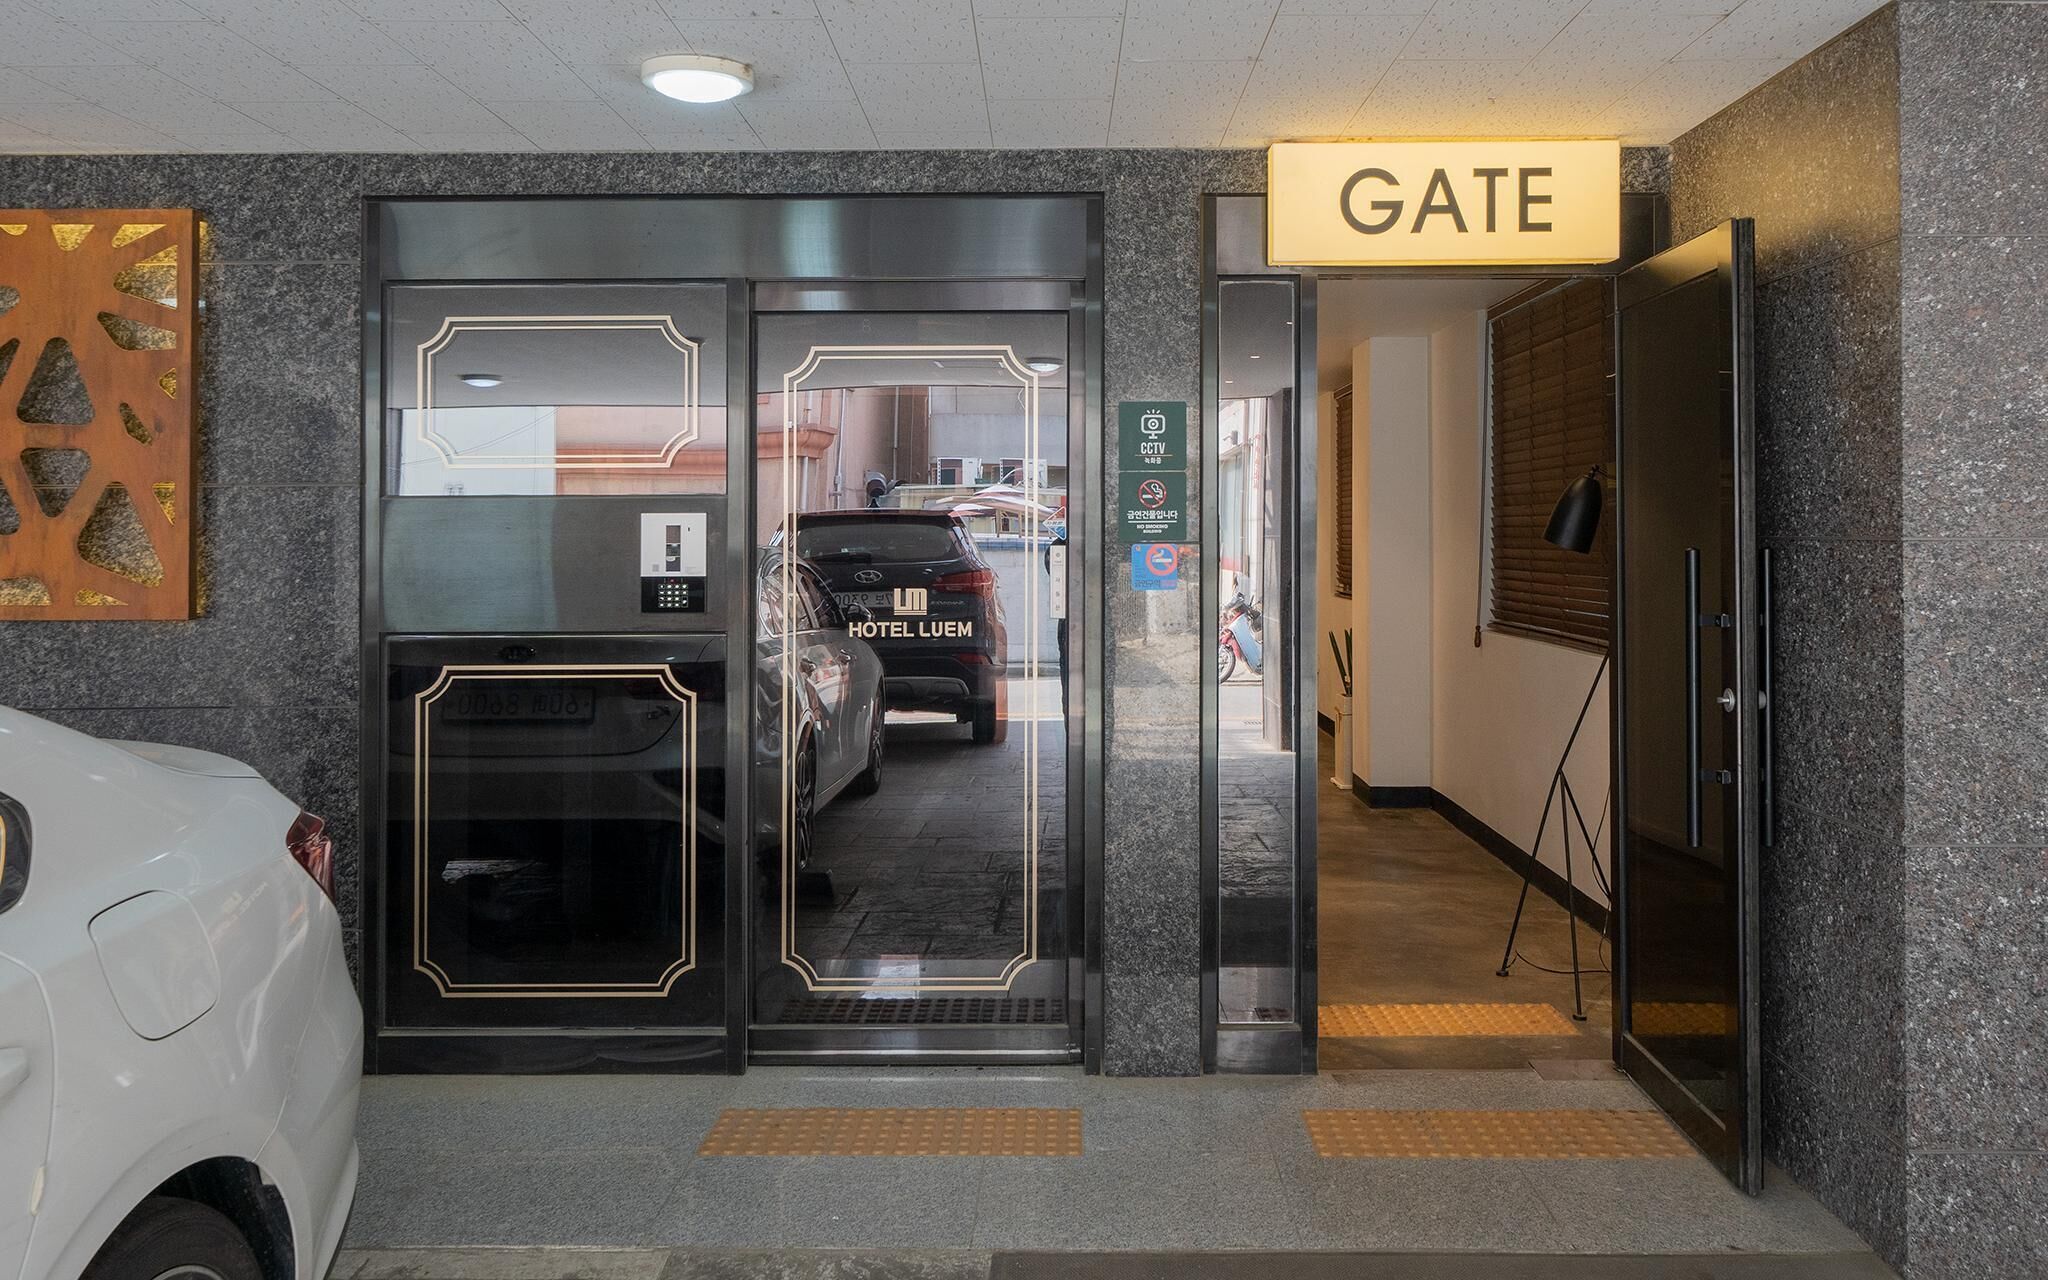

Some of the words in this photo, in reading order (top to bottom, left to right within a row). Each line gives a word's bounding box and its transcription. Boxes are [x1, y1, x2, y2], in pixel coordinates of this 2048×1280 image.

[1339, 167, 1553, 235] GATE
[1140, 442, 1166, 454] CCTV
[1127, 510, 1178, 520] 금연건물입니다
[848, 621, 914, 638] HOTEL
[919, 621, 973, 638] LUEM
